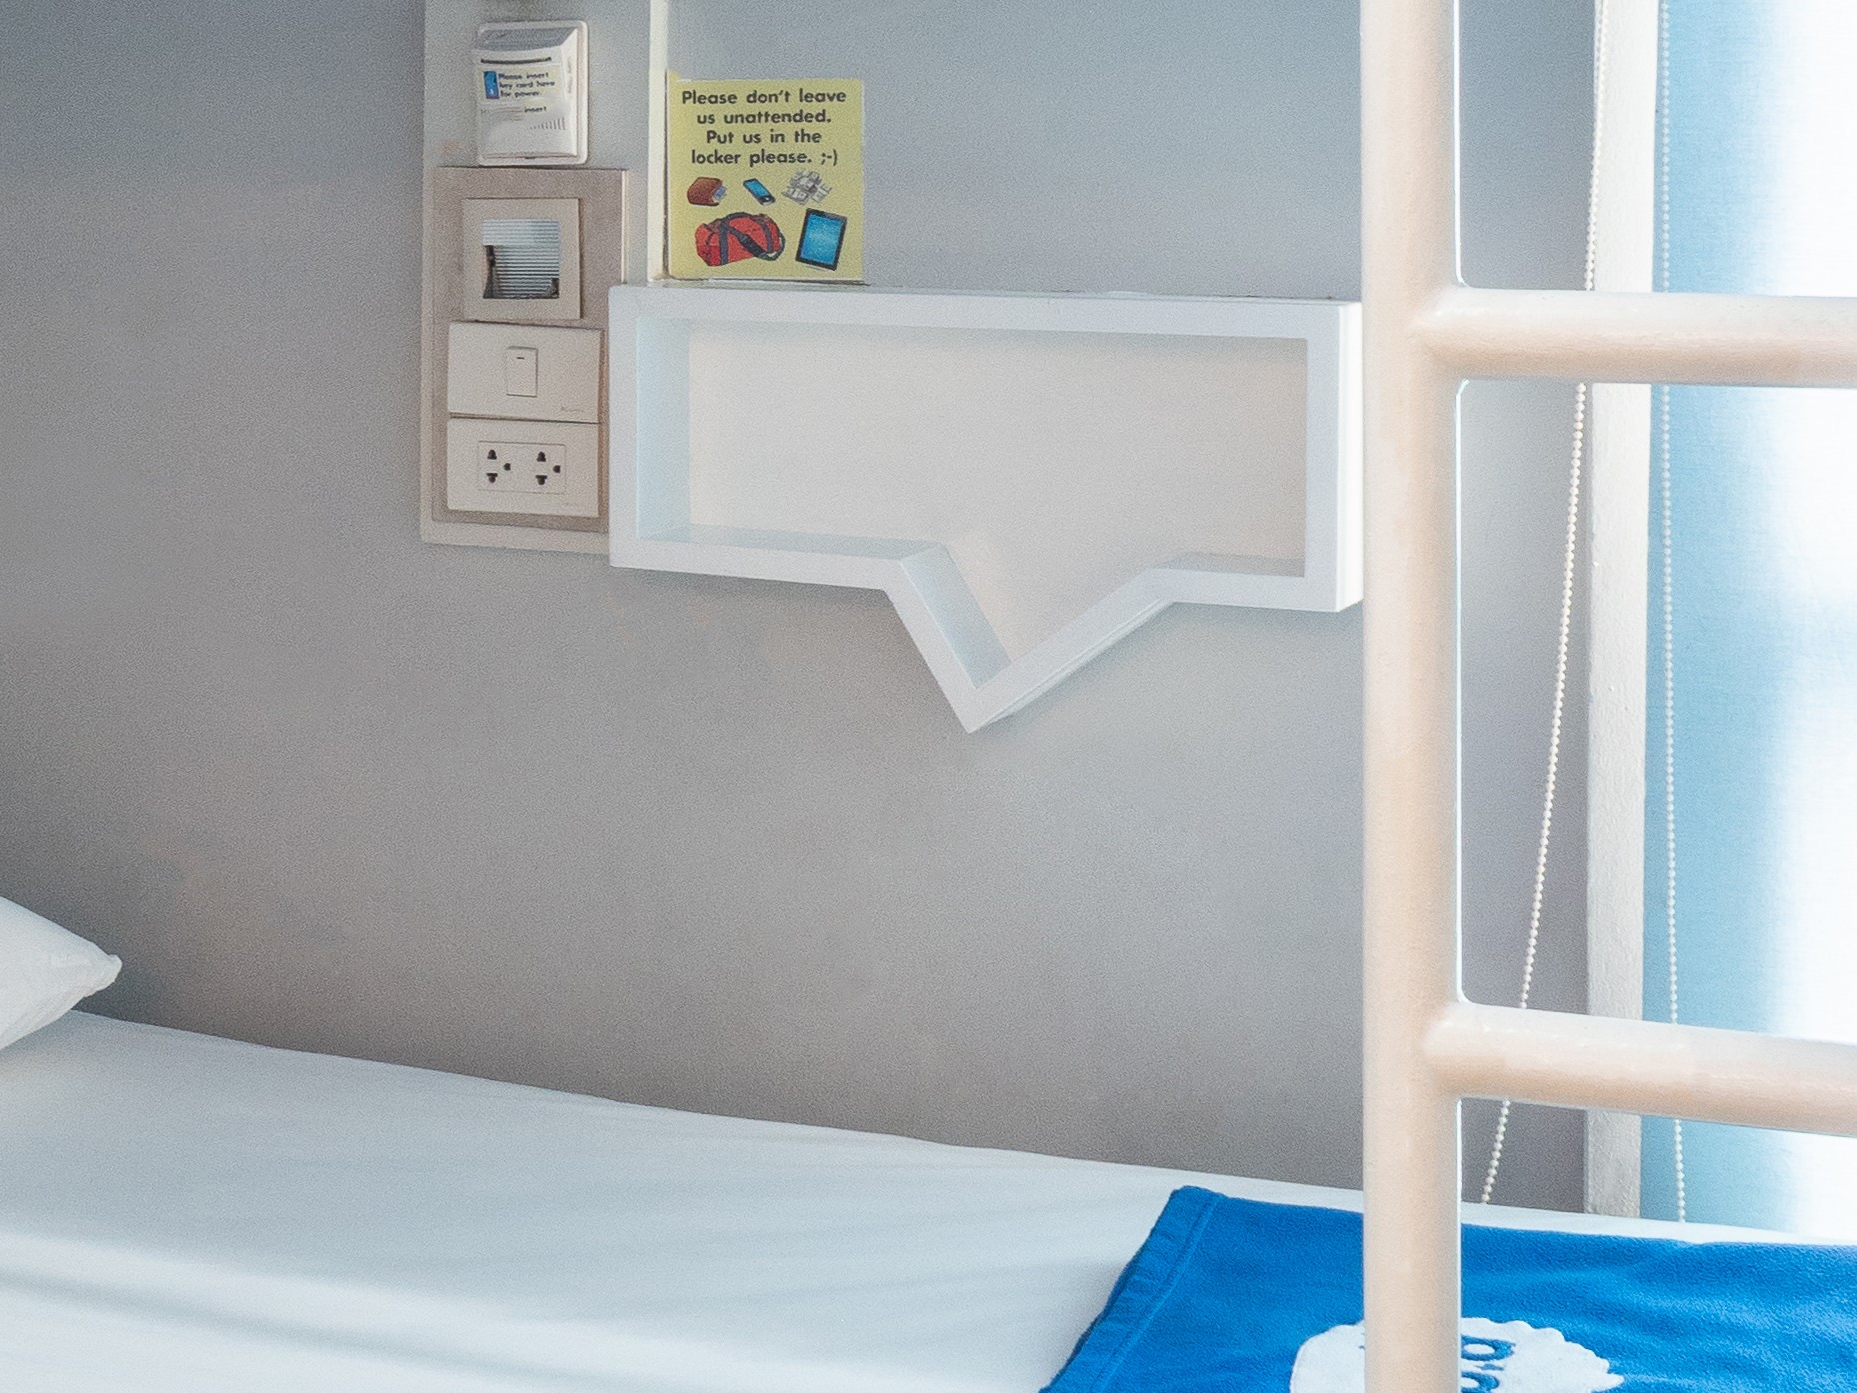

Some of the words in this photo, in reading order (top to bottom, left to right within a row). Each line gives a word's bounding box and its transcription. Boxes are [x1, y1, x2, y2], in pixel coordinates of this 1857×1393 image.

[498, 72, 523, 80] Please
[499, 81, 512, 90] key
[681, 90, 738, 105] Please
[746, 89, 791, 104] don't
[799, 88, 847, 104] leave
[524, 105, 547, 113] insert
[696, 113, 716, 125] us
[723, 109, 832, 125] unattended.
[706, 130, 735, 145] Put
[742, 133, 762, 144] us
[770, 129, 785, 143] in
[794, 128, 822, 143] the
[691, 150, 741, 165] locker
[749, 150, 812, 167] please.
